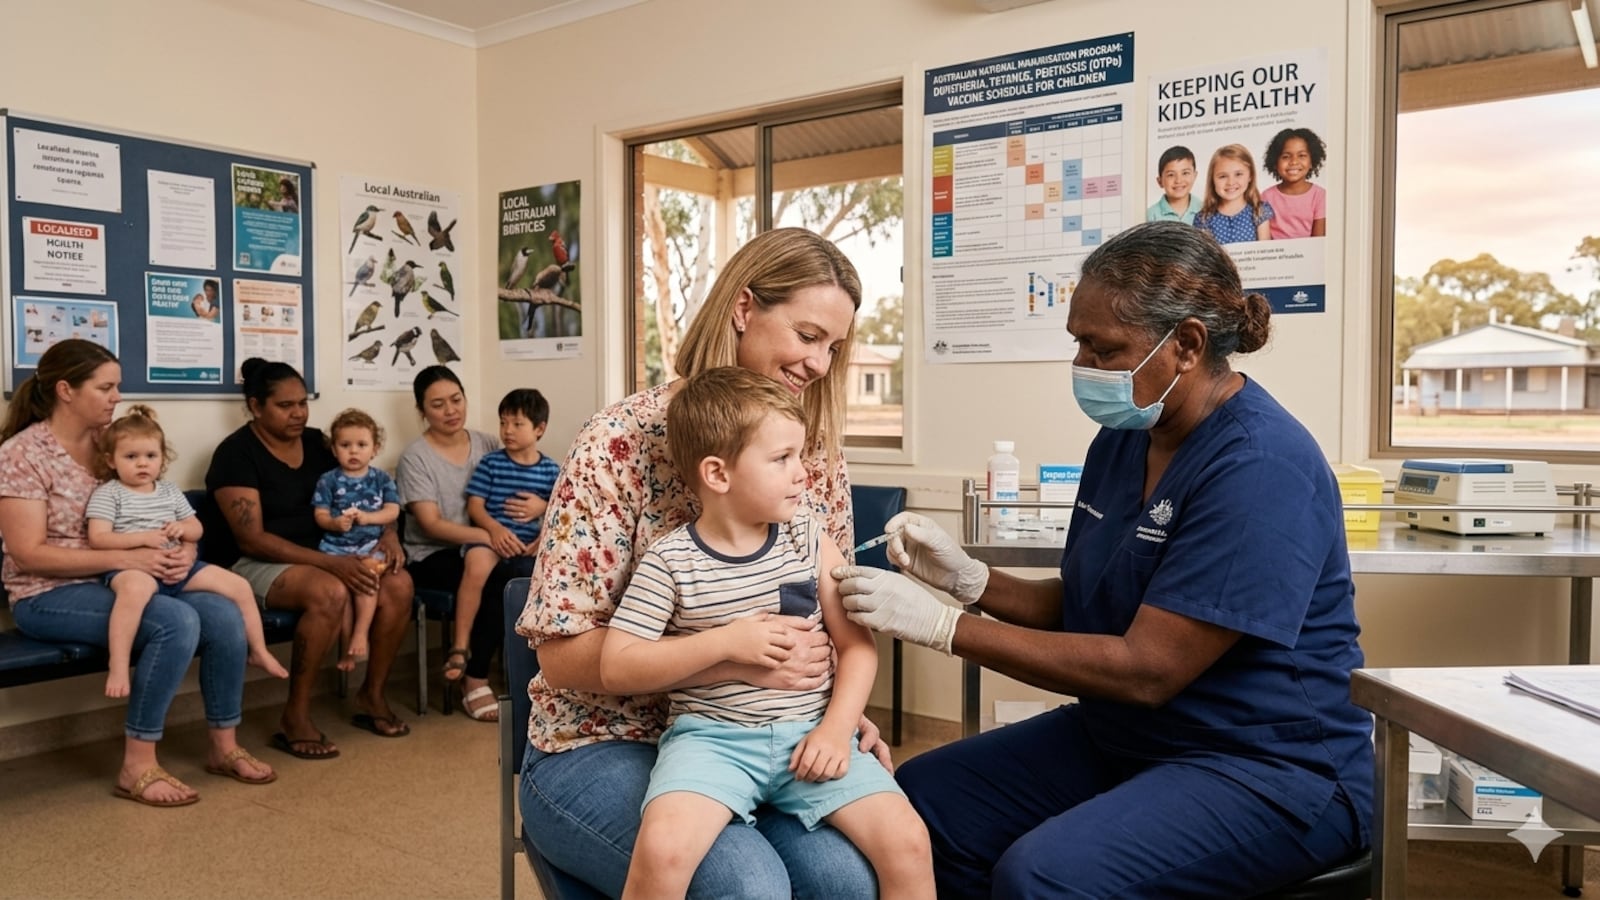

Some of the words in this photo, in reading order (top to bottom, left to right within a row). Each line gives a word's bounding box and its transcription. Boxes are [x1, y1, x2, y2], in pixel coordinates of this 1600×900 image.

[1035, 79, 1055, 93] FOR
[1158, 70, 1245, 101] KEEPING
[1252, 62, 1299, 86] OUR
[1158, 99, 1206, 123] KIDS
[1214, 82, 1316, 116] HEALTHY
[364, 182, 391, 195] Local
[502, 195, 530, 210] LOCAL
[502, 204, 556, 223] AUSTRALIAN
